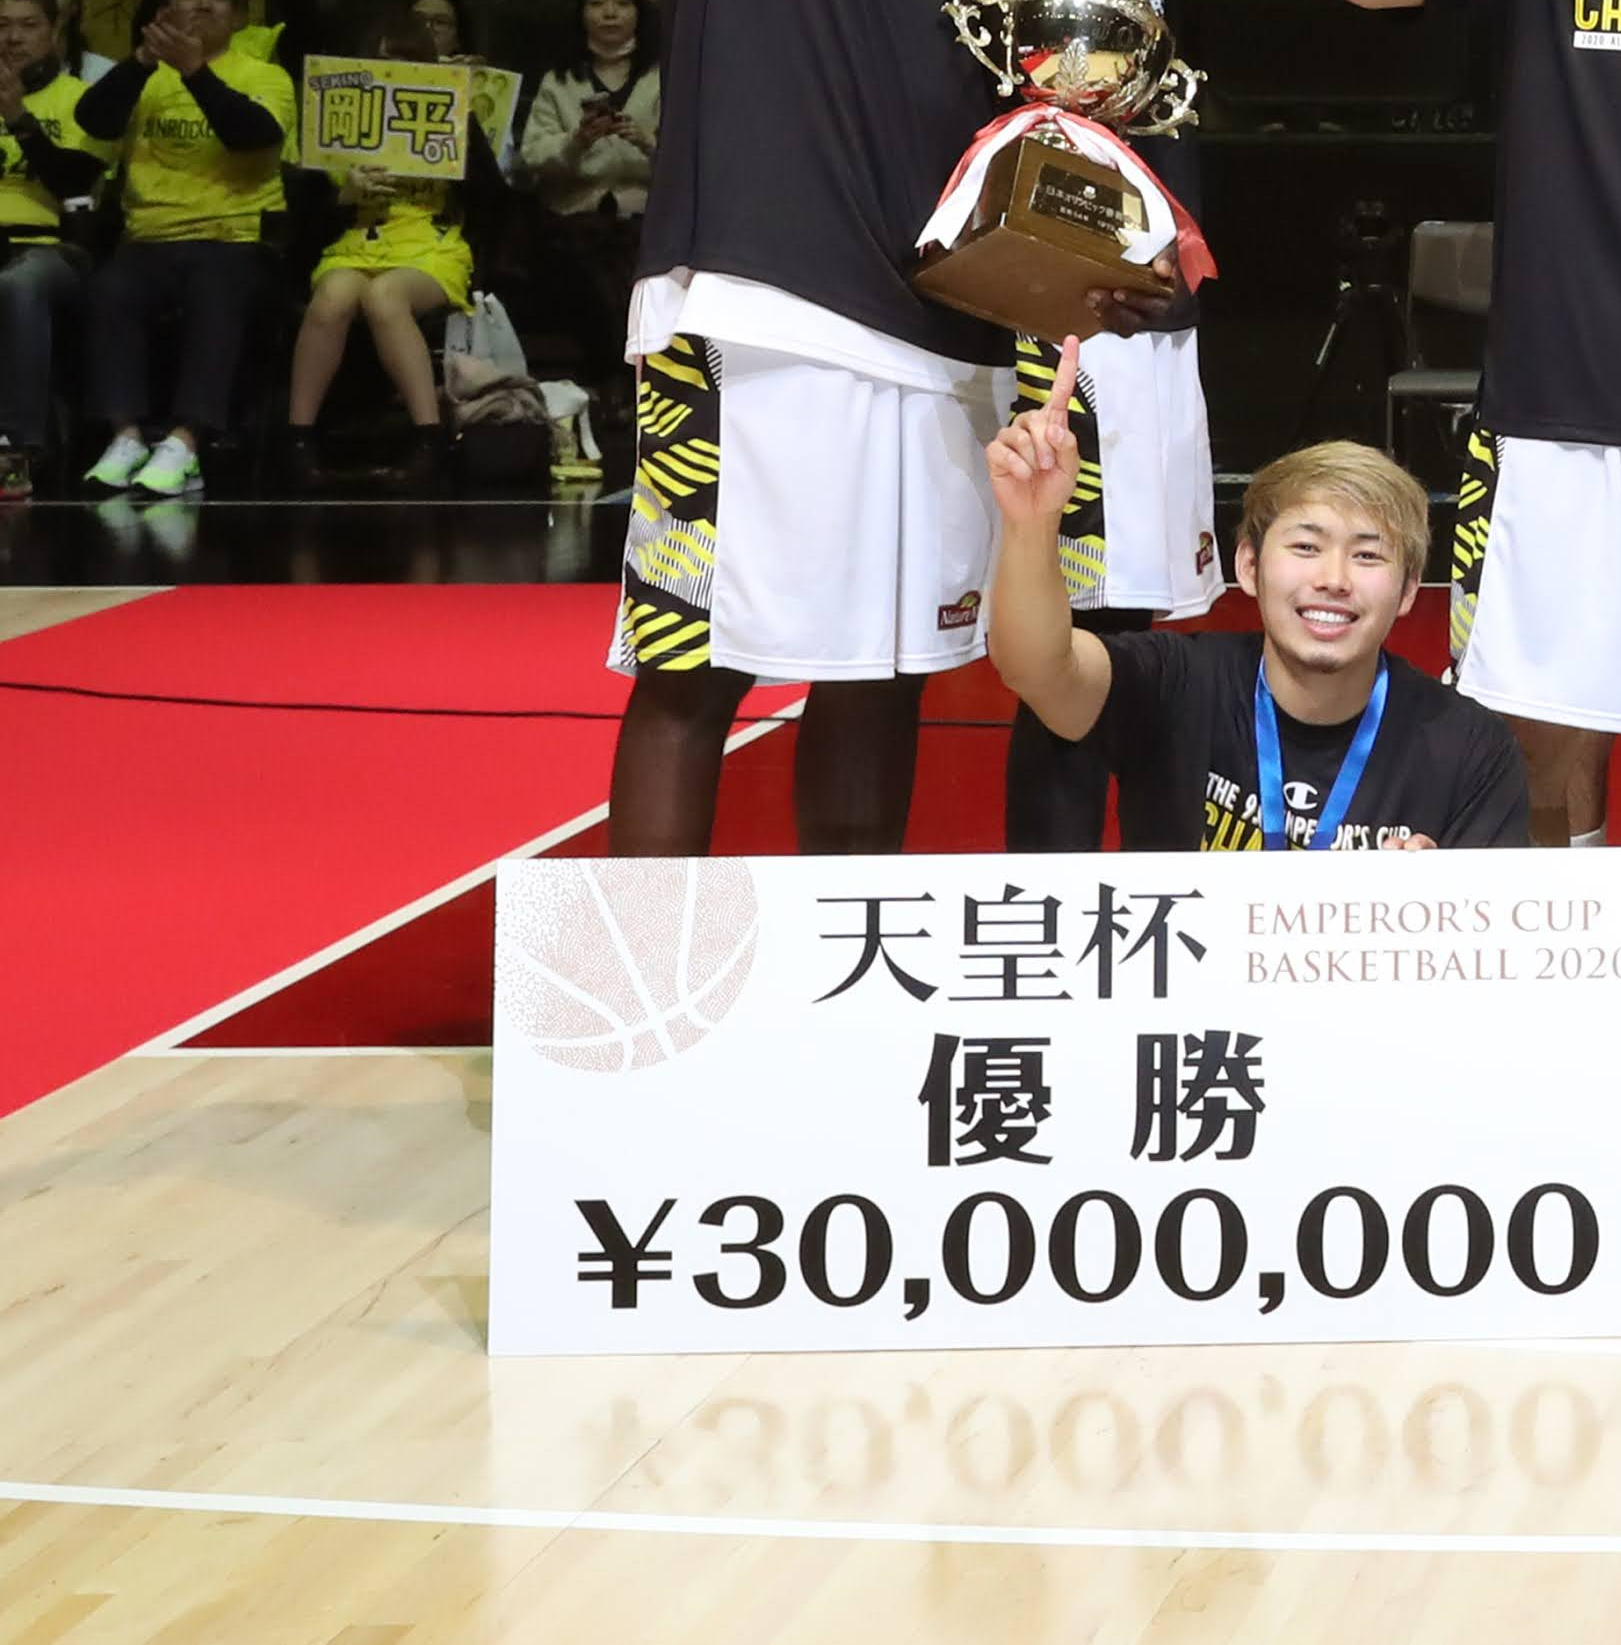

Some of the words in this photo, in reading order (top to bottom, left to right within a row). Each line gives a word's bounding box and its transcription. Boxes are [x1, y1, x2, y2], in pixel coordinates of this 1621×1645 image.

[1581, 35, 1606, 45] 2020
[309, 71, 373, 91] SEKINO
[319, 83, 457, 155] 剛平
[423, 136, 458, 164] 01
[1206, 772, 1240, 811] THE
[1246, 898, 1494, 936] EMPEROR'S
[1512, 898, 1603, 933] CUP
[812, 882, 1207, 1006] 天皇杯
[1245, 948, 1519, 984] BASKETBALL
[918, 1031, 1267, 1168] 優勝
[575, 1182, 1602, 1320] ¥30,000,000
